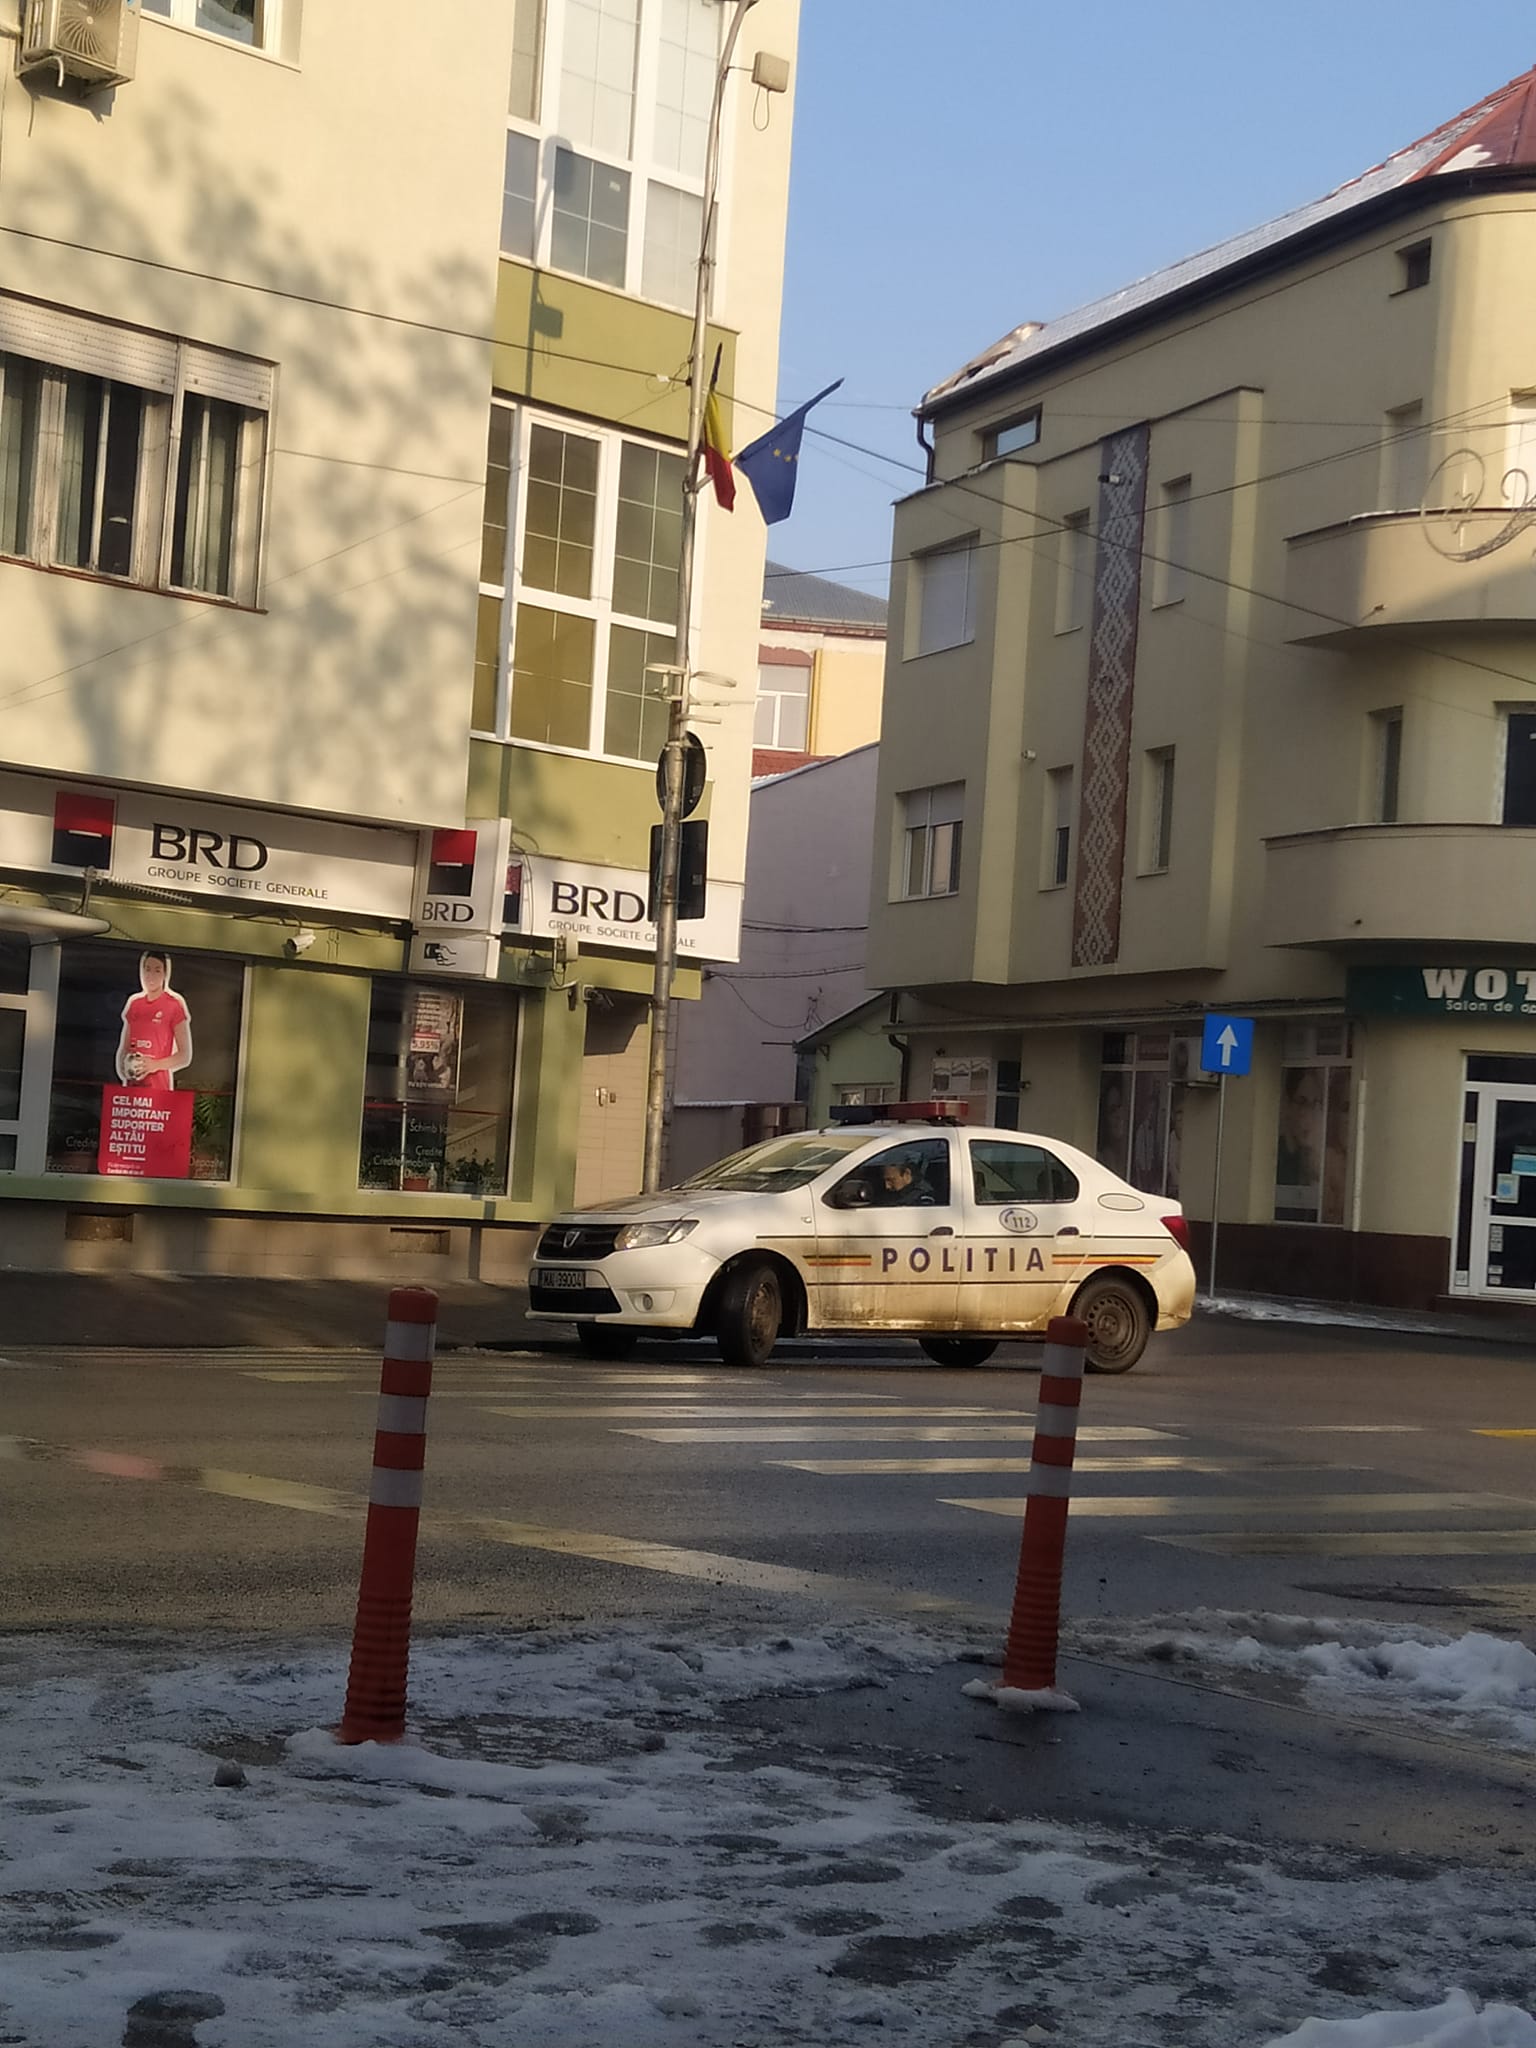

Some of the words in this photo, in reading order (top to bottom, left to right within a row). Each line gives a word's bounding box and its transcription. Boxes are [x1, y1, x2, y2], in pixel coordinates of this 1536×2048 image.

[150, 822, 269, 873] BRD
[147, 866, 201, 883] GROUPE
[208, 873, 262, 891] SOCIETE
[266, 881, 329, 900] GENERALE
[421, 901, 475, 924] BRD
[551, 880, 646, 924] BRD
[548, 919, 593, 934] GROUPE
[596, 925, 641, 941] SOCIETE
[1446, 999, 1489, 1012] Salon
[1493, 1000, 1514, 1013] de
[112, 1095, 131, 1106] CEL
[132, 1096, 153, 1108] MAI
[111, 1106, 171, 1121] IMPORTANT
[110, 1118, 165, 1132] SUPORTER
[1012, 1216, 1031, 1229] 112
[882, 1247, 1045, 1273] POLITIA
